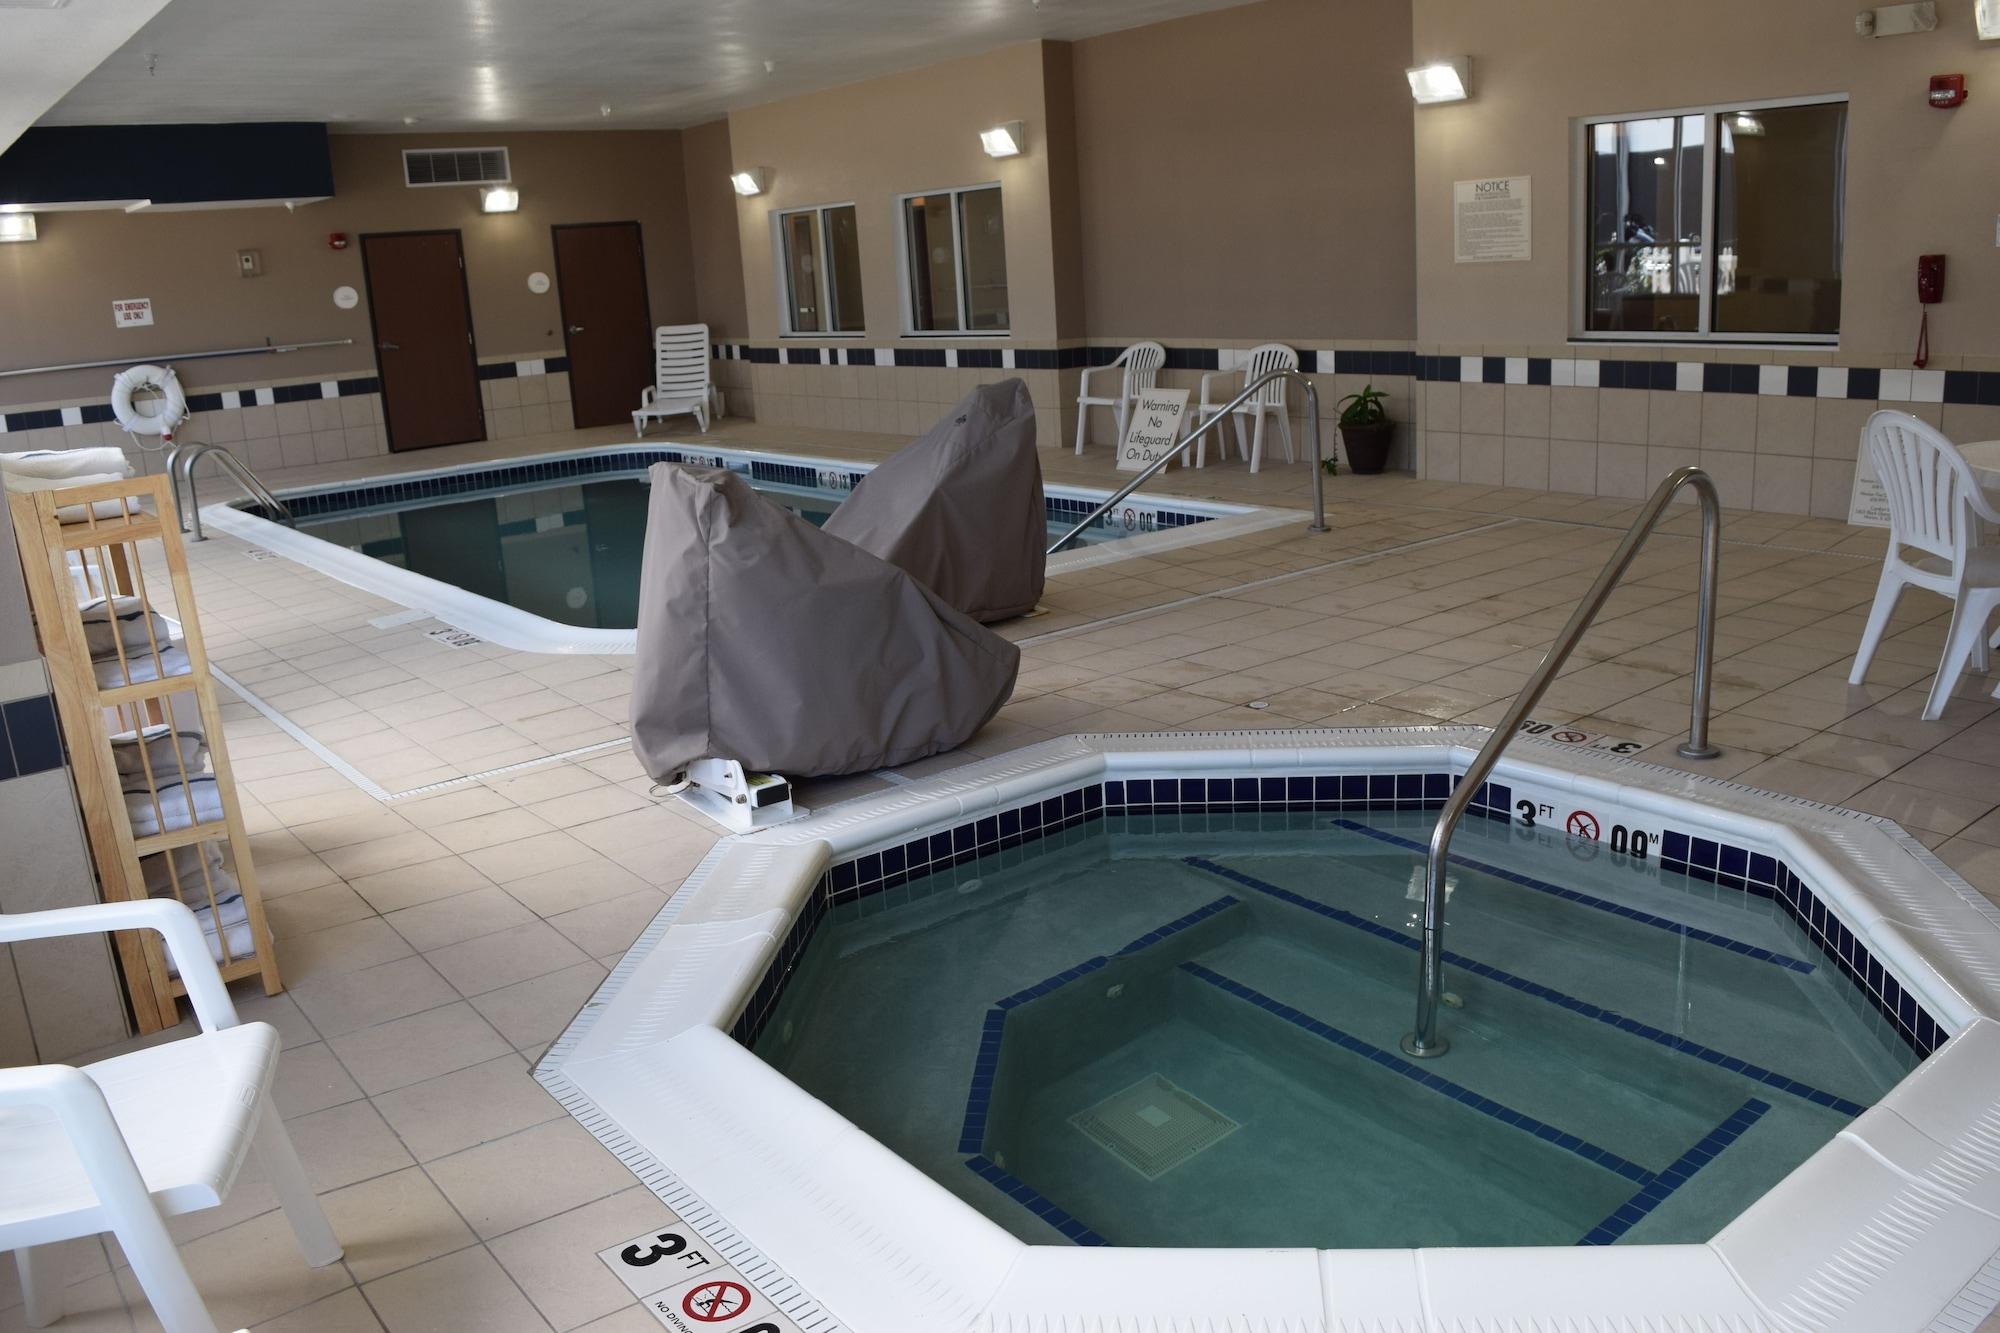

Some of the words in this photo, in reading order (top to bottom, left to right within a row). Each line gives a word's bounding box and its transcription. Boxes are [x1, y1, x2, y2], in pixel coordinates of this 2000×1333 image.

[1475, 180, 1510, 192] NOTICE
[1142, 399, 1180, 416] Warning
[1147, 416, 1163, 428] No
[1129, 430, 1173, 448] Lifeguard
[1126, 448, 1140, 460] On
[1610, 743, 1642, 753] 3
[1516, 799, 1537, 828] 3
[1539, 803, 1555, 819] FT
[1649, 832, 1659, 844] M
[620, 1233, 687, 1267] 3
[677, 1250, 710, 1269] FT
[655, 1301, 669, 1313] NO
